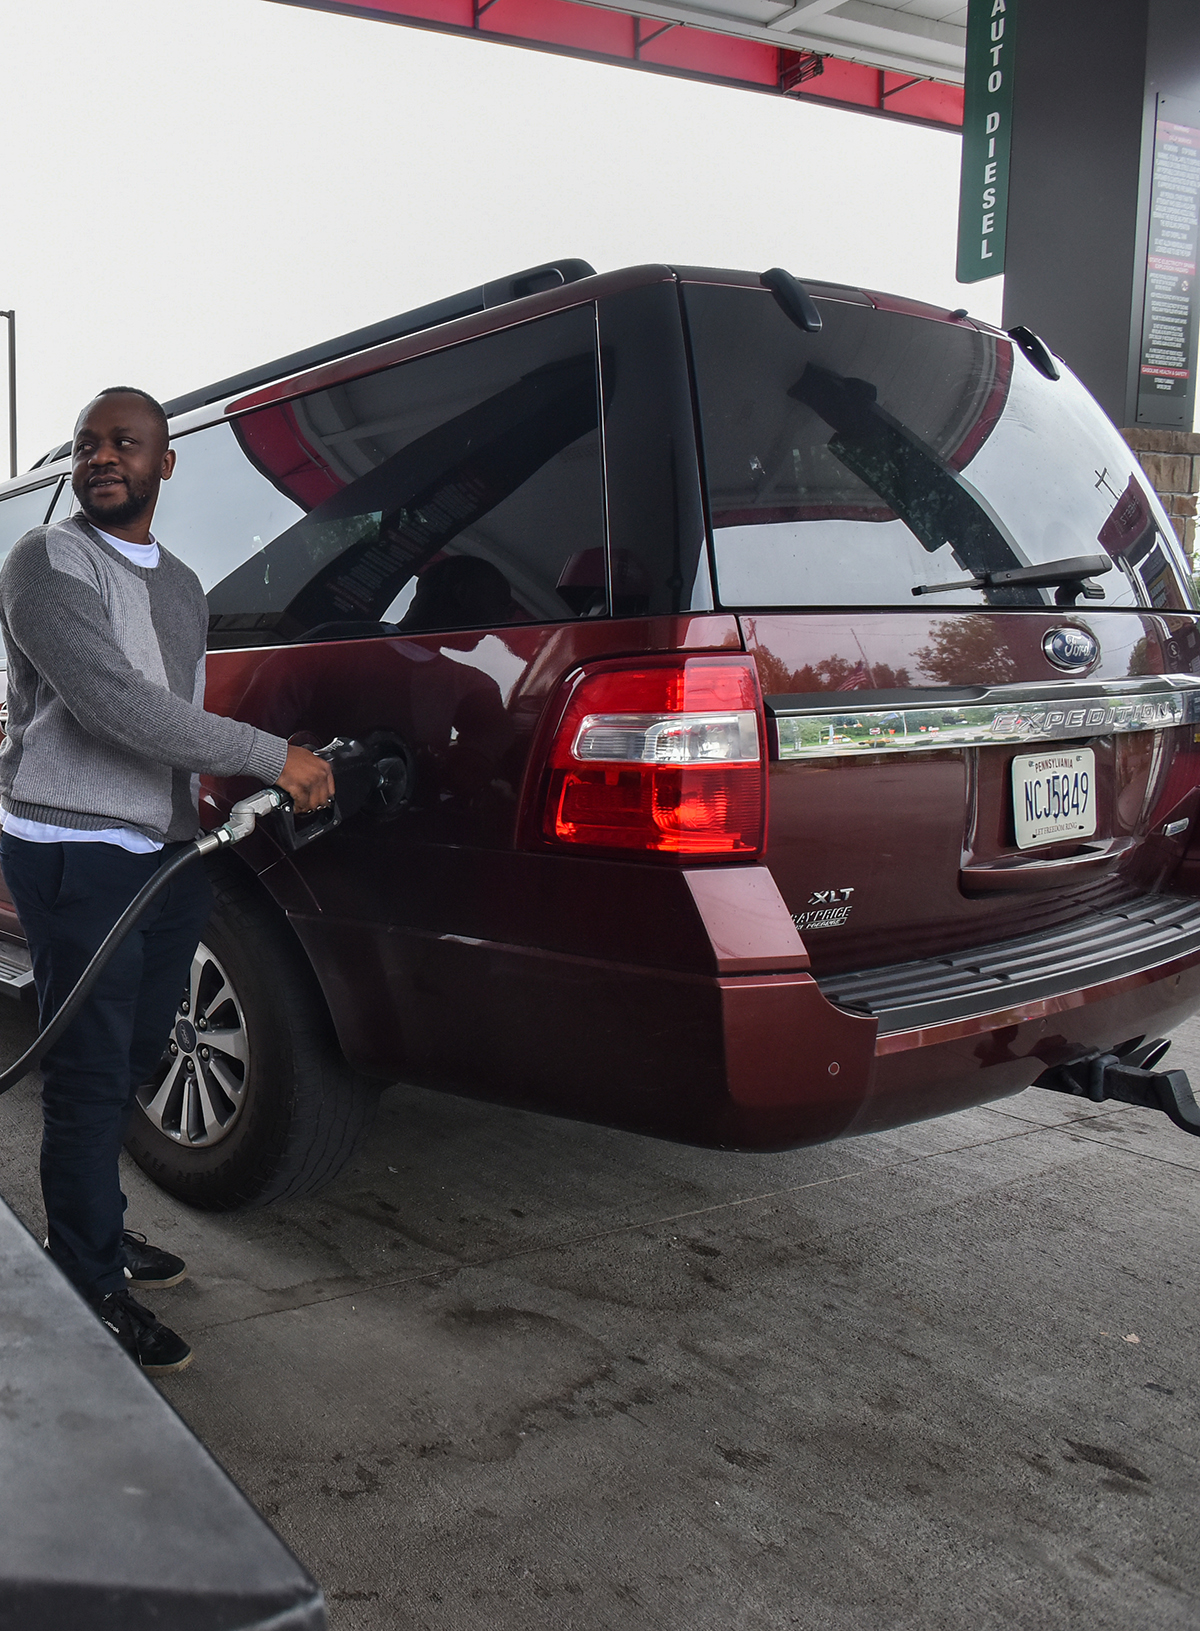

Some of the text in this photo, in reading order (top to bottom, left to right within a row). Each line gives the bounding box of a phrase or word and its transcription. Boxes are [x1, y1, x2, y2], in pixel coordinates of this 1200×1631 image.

[981, 0, 1006, 259] AUTO DIESEL
[1064, 634, 1090, 657] Ford
[992, 701, 1171, 734] EXPEDITION
[1035, 758, 1073, 773] PENNSYLVANIA
[1044, 824, 1065, 834] FREEDOM
[1066, 822, 1077, 831] RING
[808, 887, 854, 905] XLT
